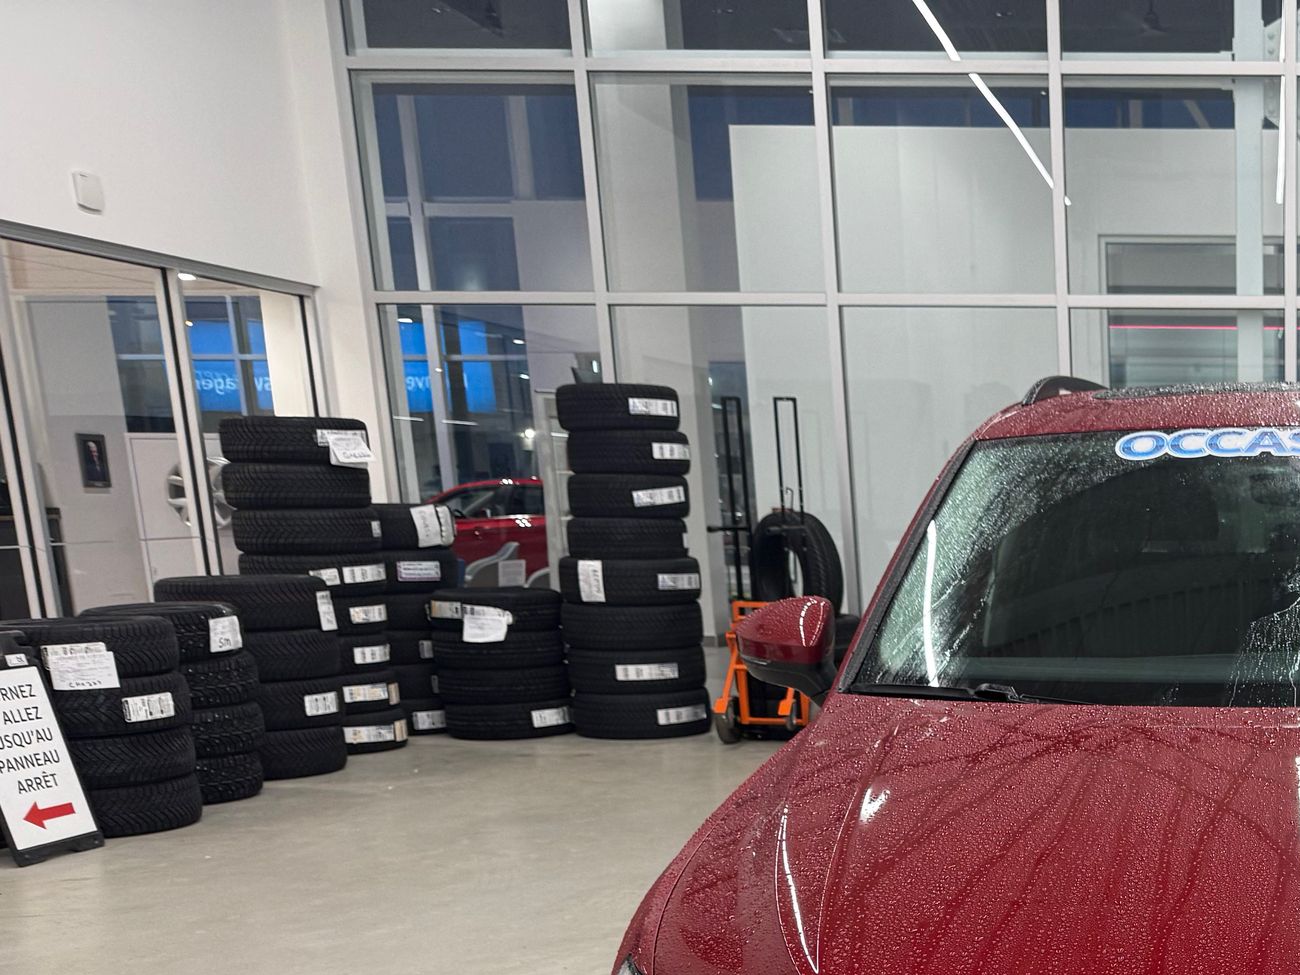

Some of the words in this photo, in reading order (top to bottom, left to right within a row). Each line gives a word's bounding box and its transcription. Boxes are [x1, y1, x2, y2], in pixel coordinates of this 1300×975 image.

[2, 706, 43, 725] ALLEZ
[0, 749, 60, 774] PANNEAU
[17, 771, 59, 794] ARRÊT
